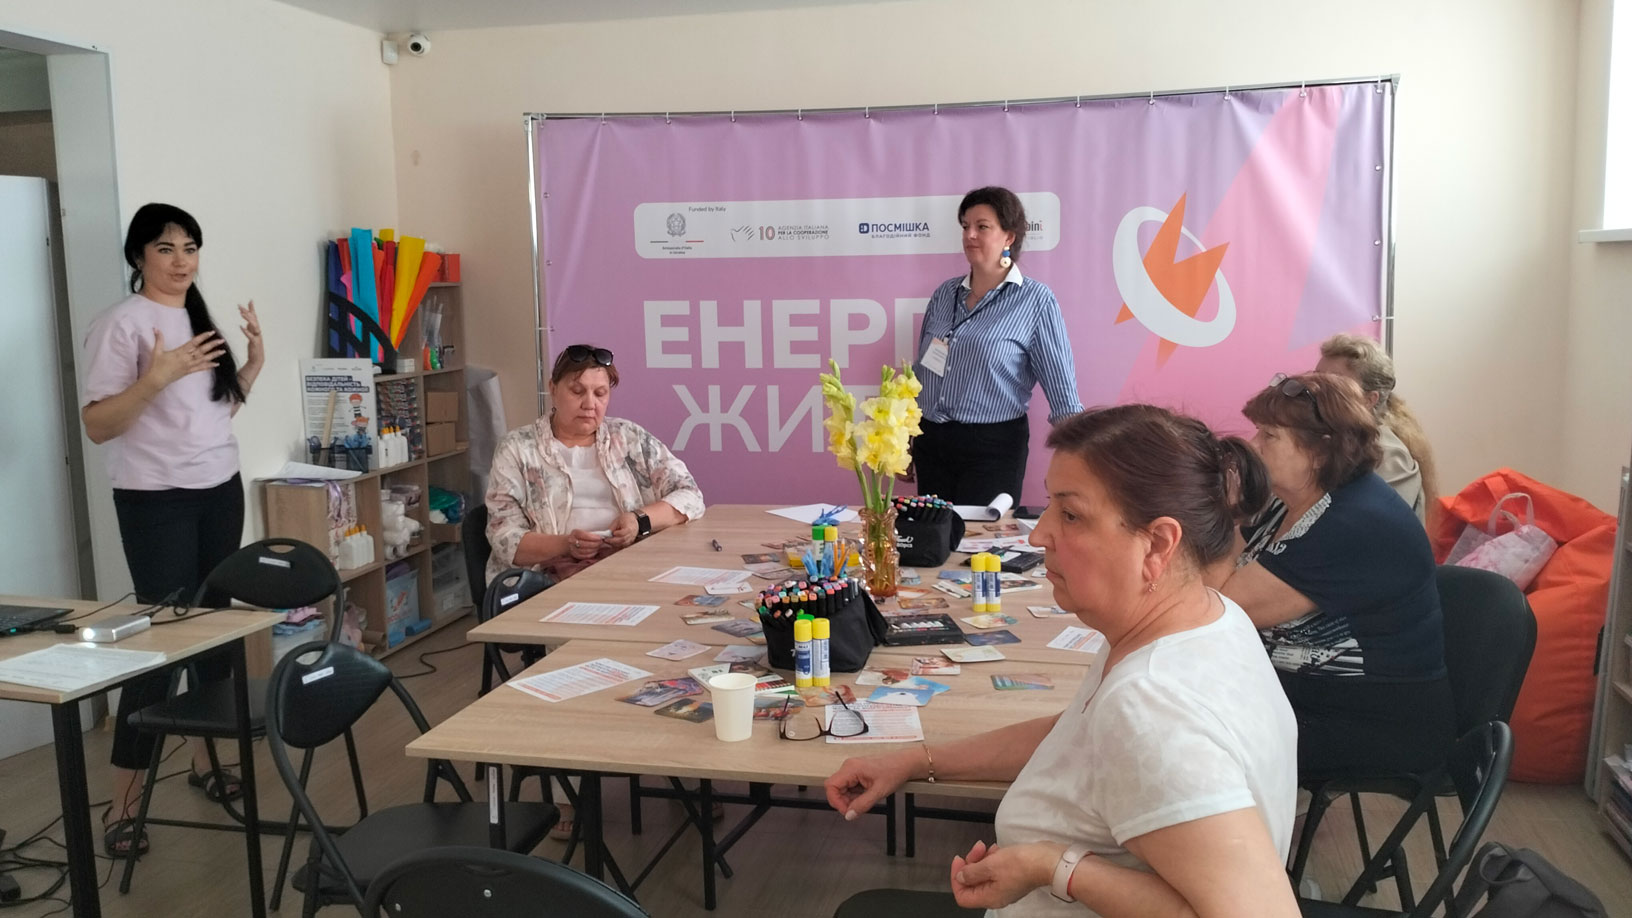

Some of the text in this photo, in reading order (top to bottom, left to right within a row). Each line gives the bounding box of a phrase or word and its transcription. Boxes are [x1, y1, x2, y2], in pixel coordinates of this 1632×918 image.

[759, 225, 775, 241] 10
[871, 222, 930, 232] ПОСМІШКА
[643, 298, 931, 369] ЕНЕРГ
